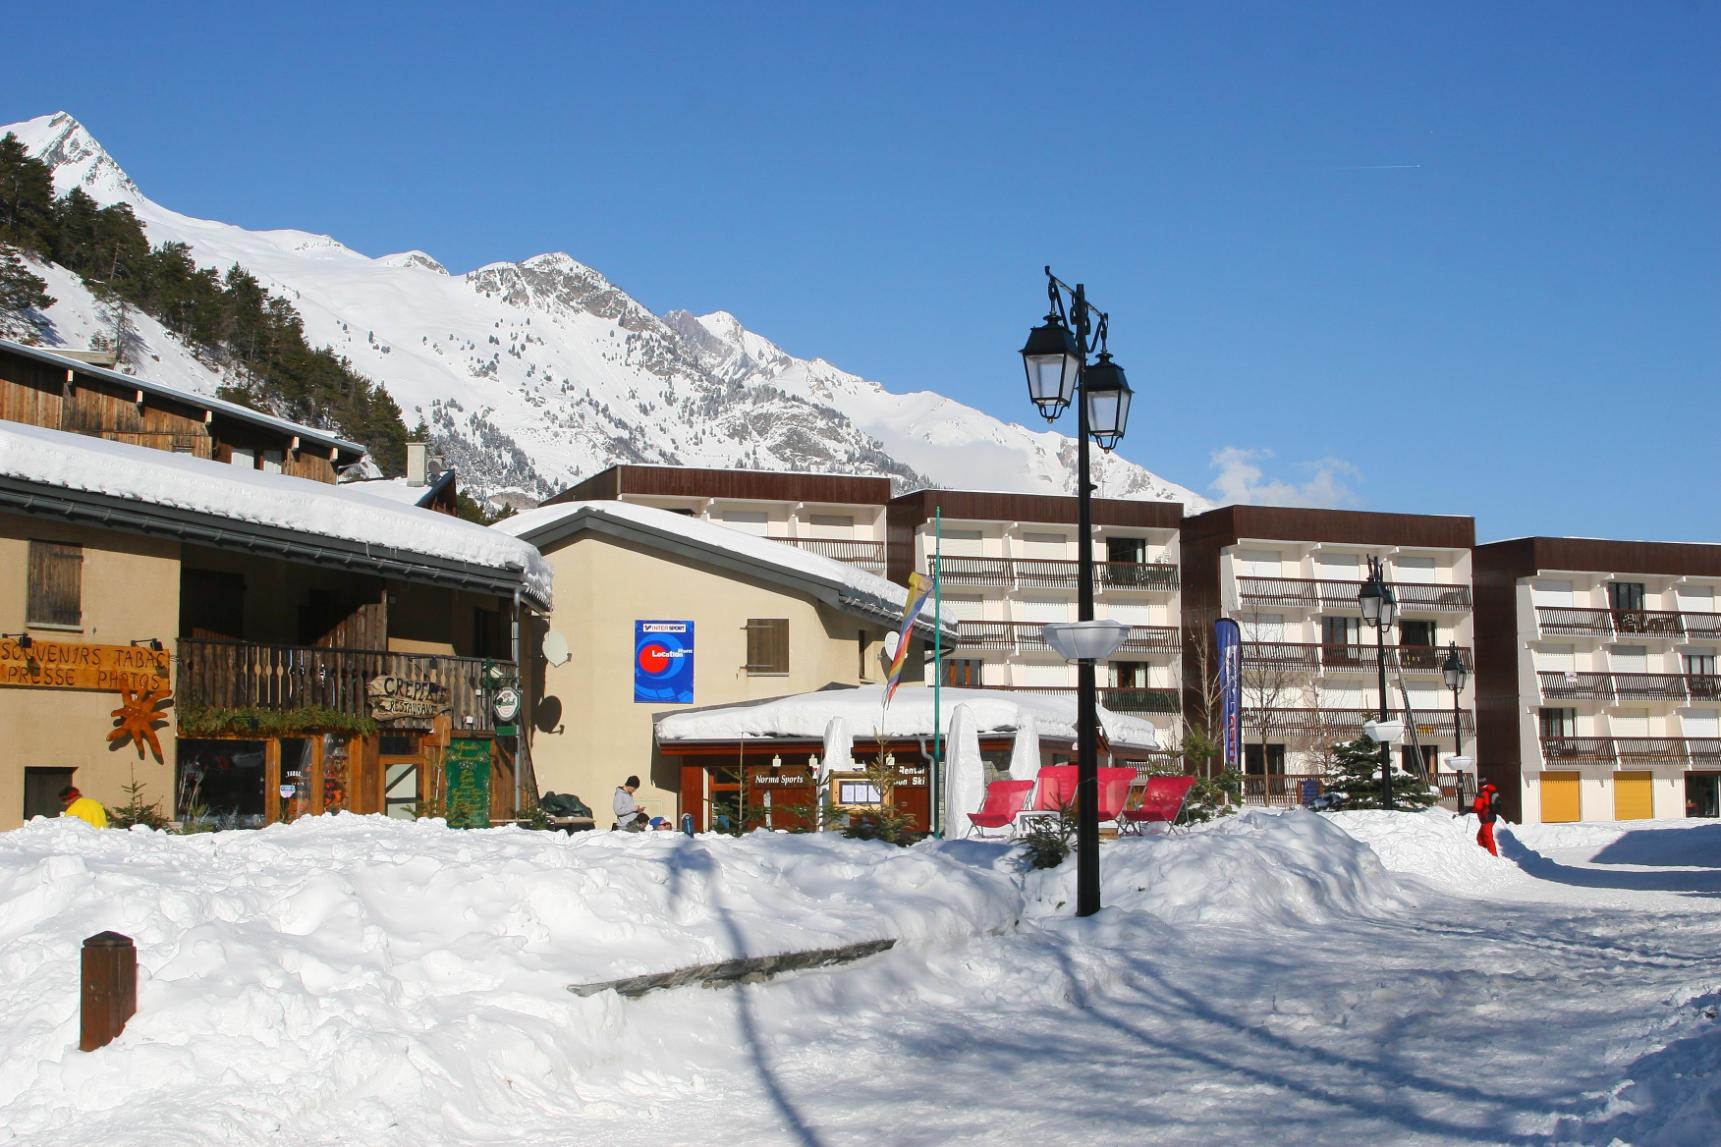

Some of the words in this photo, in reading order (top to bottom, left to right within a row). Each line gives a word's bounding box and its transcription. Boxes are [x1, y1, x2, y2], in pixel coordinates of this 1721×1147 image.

[1, 642, 101, 665] SOUVENIRS
[115, 649, 166, 669] TABAC
[652, 650, 684, 658] Location
[7, 666, 76, 686] PRESSE
[899, 765, 925, 775] Rental
[755, 775, 779, 784] Norma
[781, 774, 804, 787] Sports
[912, 776, 926, 786] Ski
